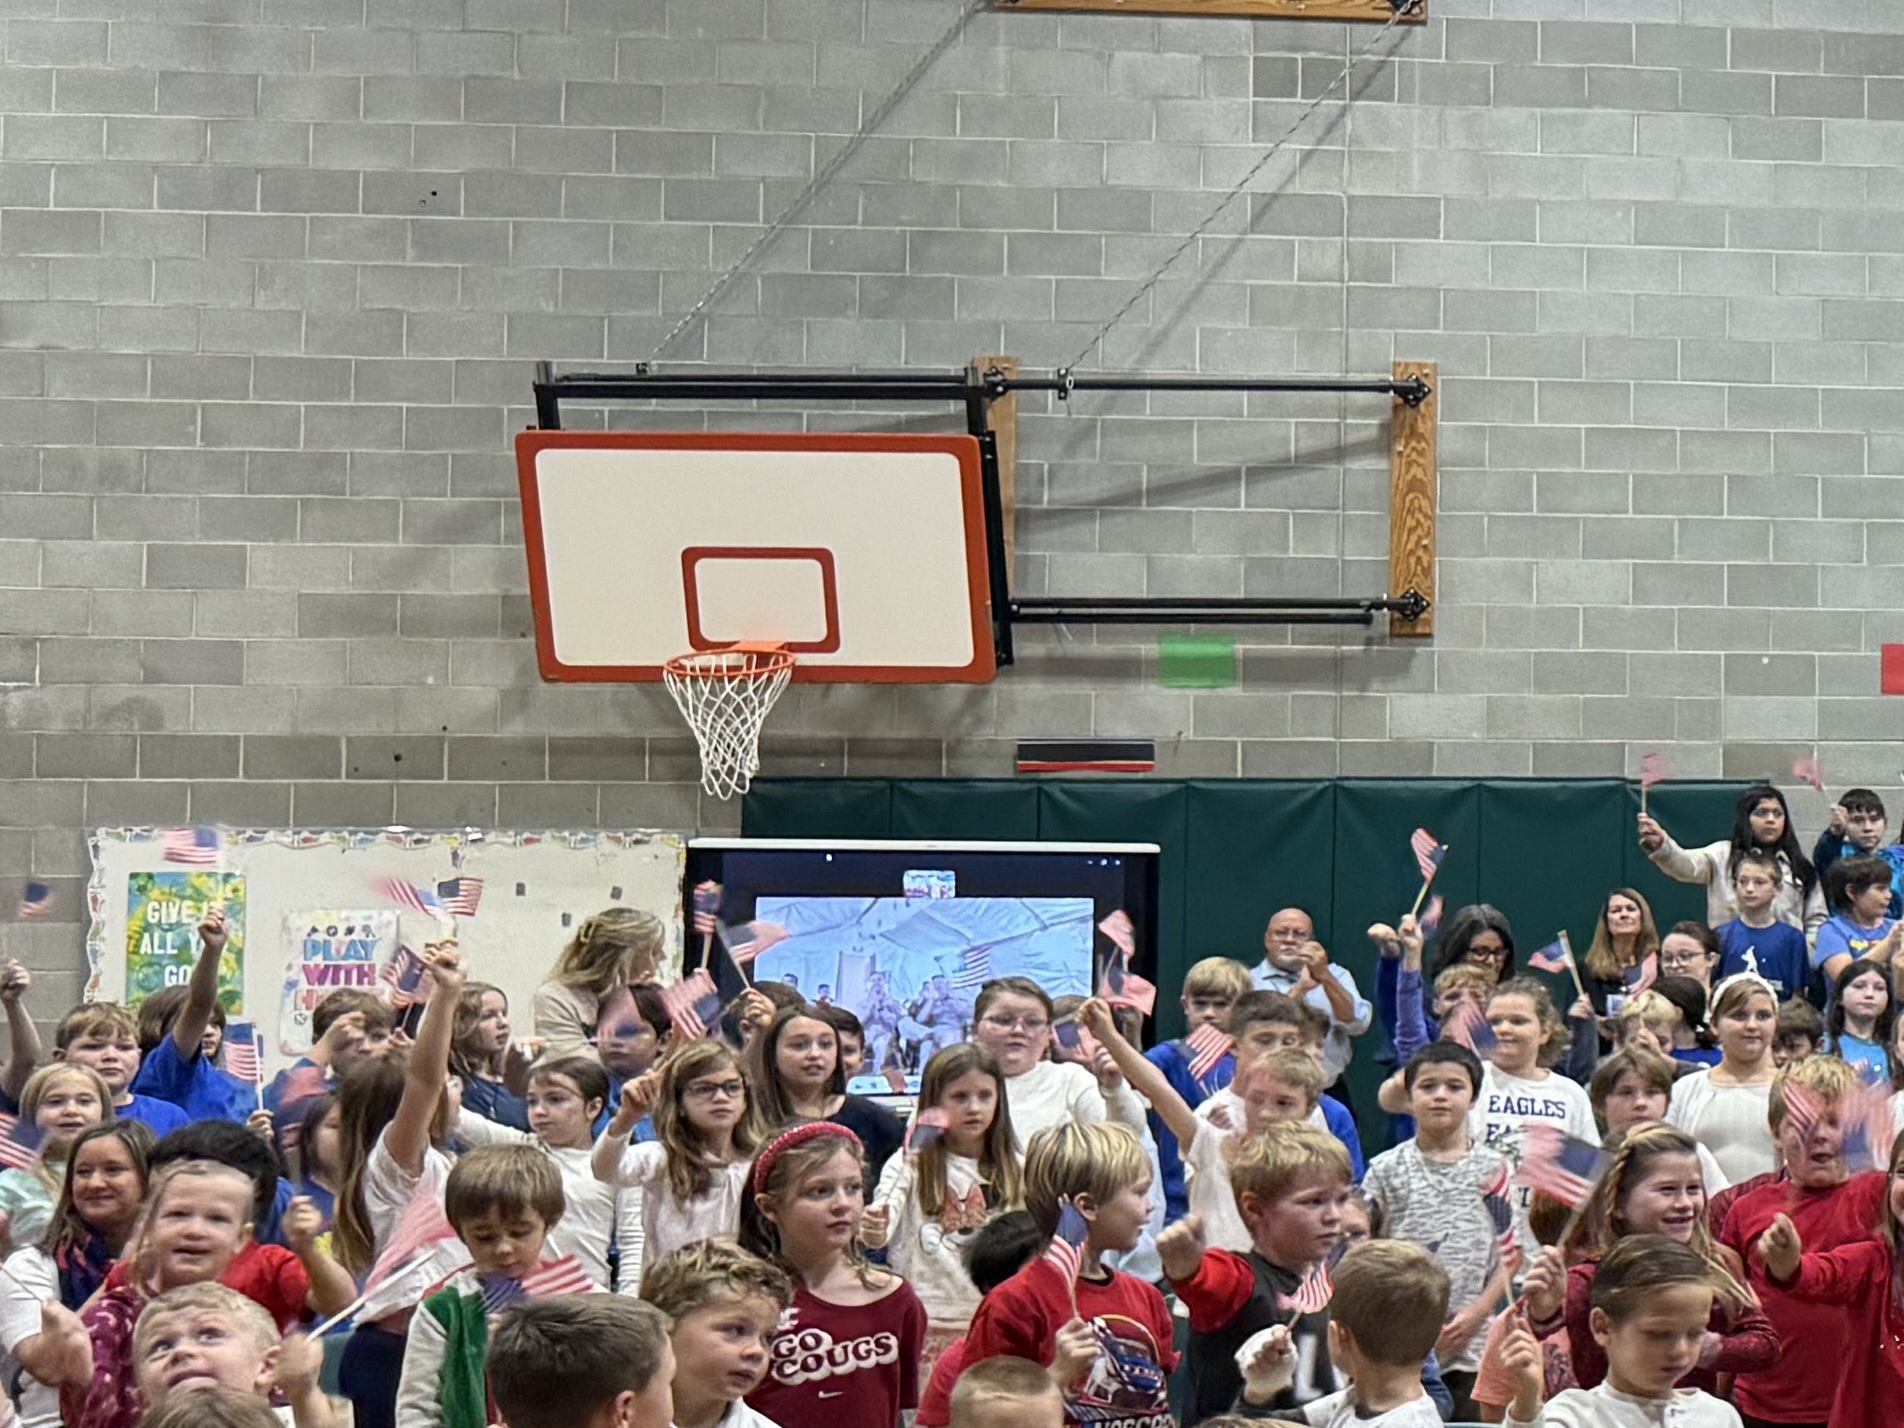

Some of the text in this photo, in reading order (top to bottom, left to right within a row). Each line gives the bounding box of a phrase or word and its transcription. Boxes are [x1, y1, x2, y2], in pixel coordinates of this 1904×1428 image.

[146, 900, 192, 924] GIVE
[140, 932, 178, 955] ALL
[303, 939, 379, 962] PLAY
[302, 963, 377, 987] WITH
[1488, 1095, 1566, 1119] EAGLES
[771, 1329, 830, 1360] GO
[773, 1333, 898, 1381] COUGS
